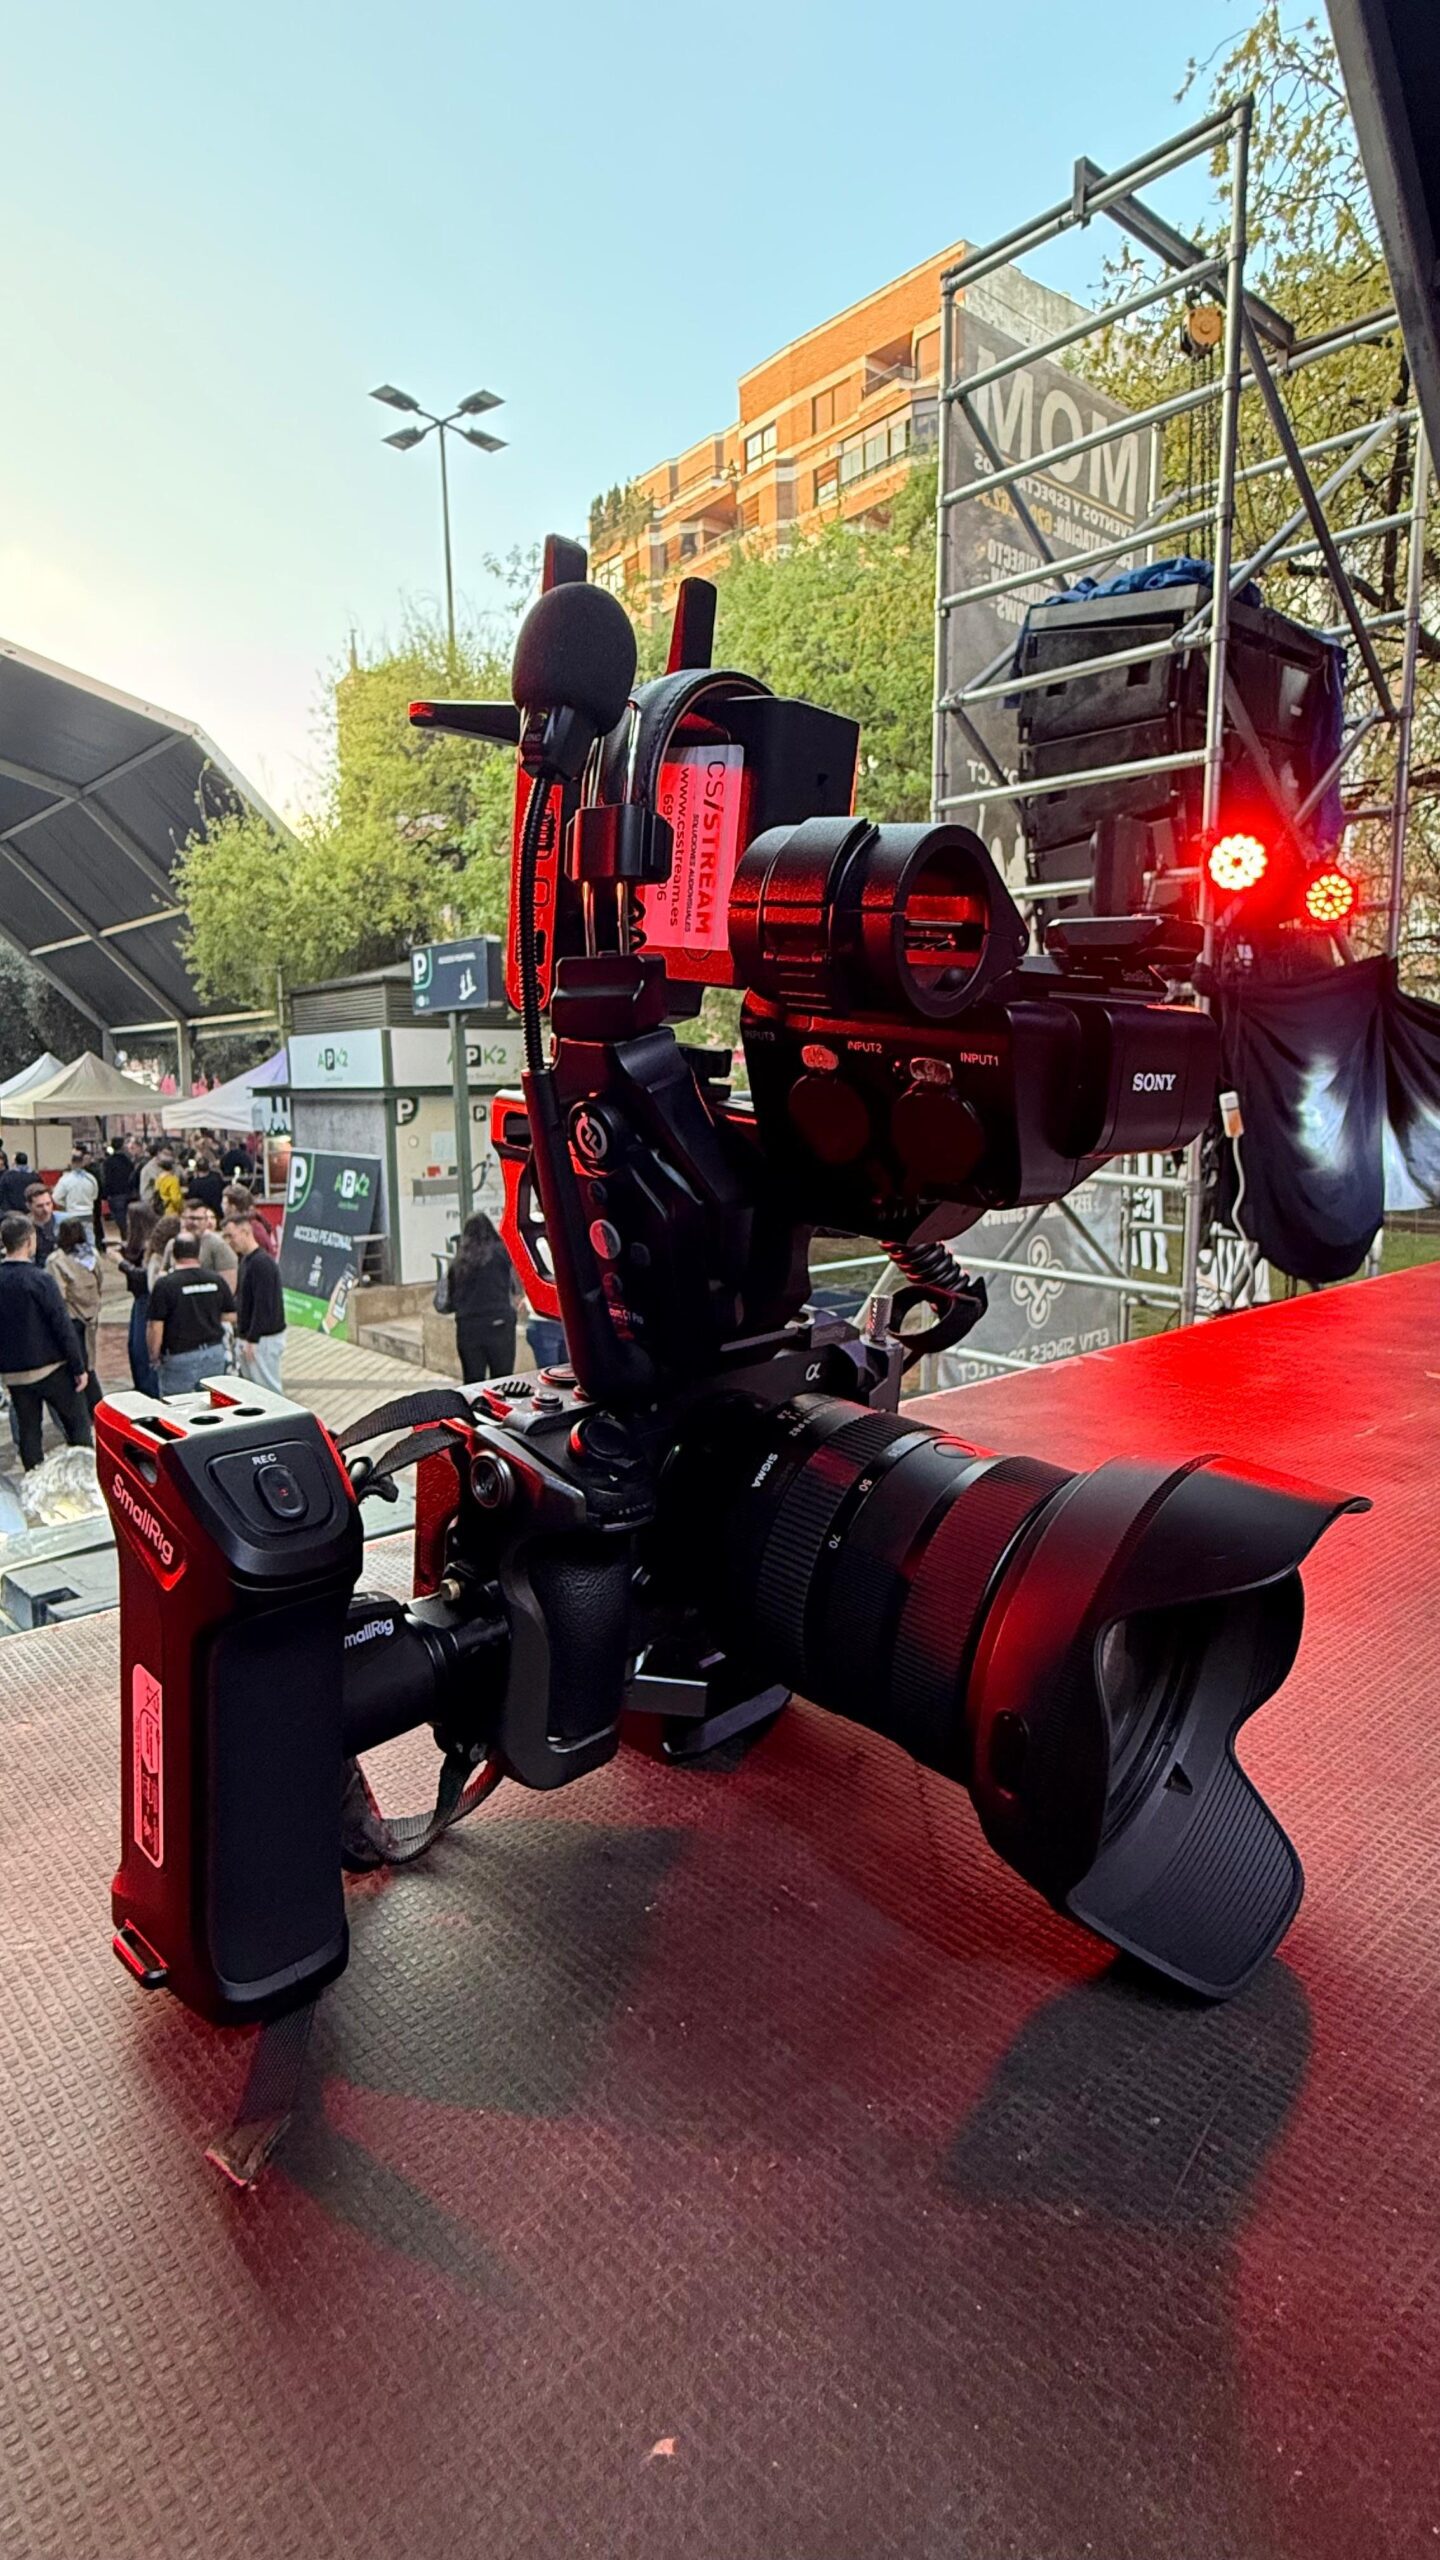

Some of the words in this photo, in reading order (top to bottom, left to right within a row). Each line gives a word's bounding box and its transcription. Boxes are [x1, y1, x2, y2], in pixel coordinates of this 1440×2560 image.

[670, 767, 690, 927] www.csstream.es
[689, 813, 700, 867] SOLUCIONES
[684, 868, 695, 932] AUDIOVISUALES
[447, 1045, 507, 1067] PK2
[847, 1040, 882, 1054] INPUT2
[960, 1052, 999, 1066] INPUT1
[1132, 1072, 1176, 1092] SONY
[252, 1453, 277, 1465] REC
[751, 1452, 779, 1488] SIGMA
[858, 1478, 873, 1492] 50
[112, 1474, 174, 1565] SmallRig
[828, 1533, 842, 1550] 70
[344, 1617, 394, 1649] mallRig
